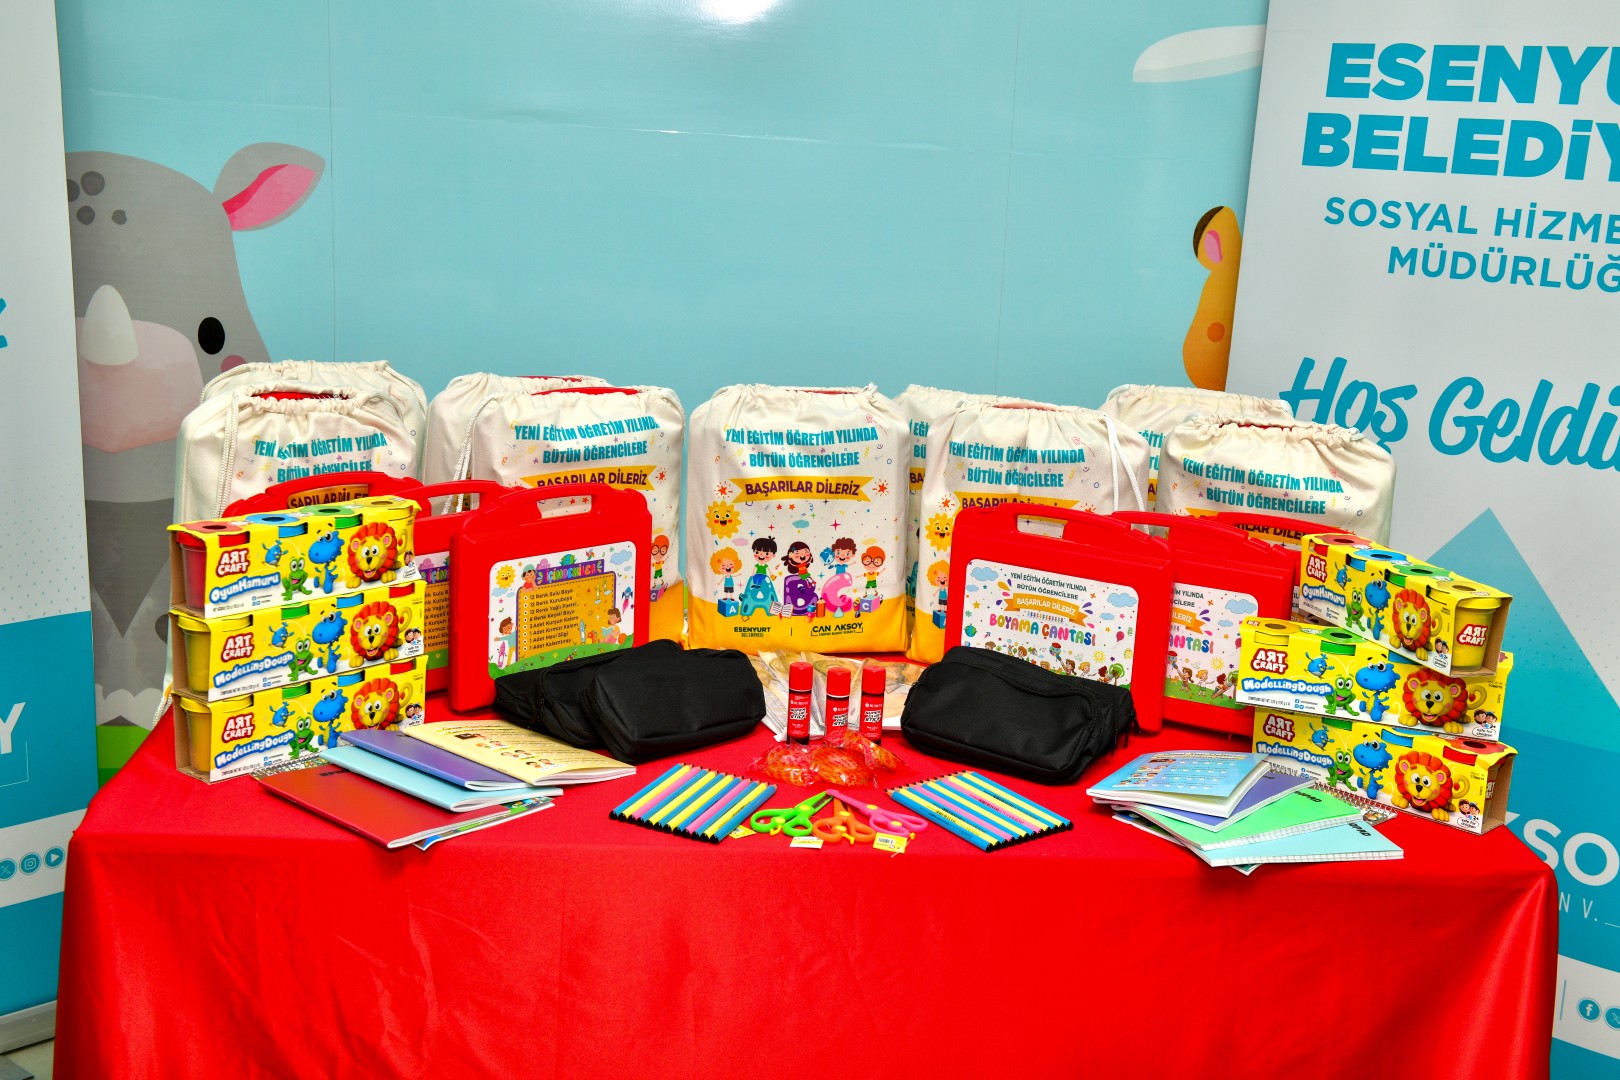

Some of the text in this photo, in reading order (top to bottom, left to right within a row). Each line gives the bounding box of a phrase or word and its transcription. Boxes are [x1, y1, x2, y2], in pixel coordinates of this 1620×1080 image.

[1325, 42, 1620, 106] ESENY
[1323, 197, 1479, 235] SOSYAL
[515, 424, 540, 440] YENİ
[543, 424, 577, 442] EĞİTİM
[578, 420, 625, 439] ÖĞRETİM
[747, 428, 784, 445] EĞİTİM
[786, 429, 835, 446] ÖĞRETİM
[836, 427, 878, 443] YILINDA
[255, 440, 276, 457] YENİ
[311, 436, 352, 456] ÖĞRETİM
[543, 441, 648, 464] BÜTÜN ÖĞRENCİLERE
[949, 441, 966, 457] YENİ
[968, 443, 1004, 462] EĞİTİM
[1041, 449, 1085, 464] YILINDA
[749, 452, 859, 468] BÜTÜN ÖĞRENCİLERE
[609, 469, 647, 486] DİLERİZ
[910, 472, 925, 484] BA
[968, 467, 1002, 485] BÜTÜN
[1183, 457, 1344, 493] YENİ EĞİTİM ÖĞRETİM YILINDA
[745, 479, 860, 497] BAŞARILAR DİLERİZ
[1207, 487, 1326, 514] BÜTÜN ÖĞRENCİLERE
[220, 550, 247, 565] ART
[1310, 557, 1325, 571] ART
[217, 562, 248, 575] CRAFT
[1307, 566, 1326, 581] CRAFT
[210, 574, 279, 602] OyunHamuru
[1011, 572, 1087, 592] YENİ EĞİTİM ÖĞRETİM YILINDA
[1017, 583, 1078, 600] BÜTÜN ÖĞRENCİLERE
[1182, 590, 1204, 599] YILINDA
[1016, 598, 1076, 616] BAŞARILAR DİLERİZ
[812, 622, 863, 633] CAN AKSOY
[989, 613, 1096, 646] BOYAMA ÇANTASI
[1464, 626, 1487, 637] ART
[226, 635, 252, 649] ART
[1459, 635, 1485, 645] CRAFT
[223, 646, 253, 660] CRAFT
[1257, 650, 1285, 665] ART
[1253, 660, 1286, 673] CRAFT
[226, 715, 252, 730] ART
[1268, 716, 1292, 731] ART
[223, 726, 253, 740] CRAFT
[1265, 726, 1293, 740] CRAFT
[1505, 811, 1620, 887] SO
[1583, 897, 1598, 922] V.
